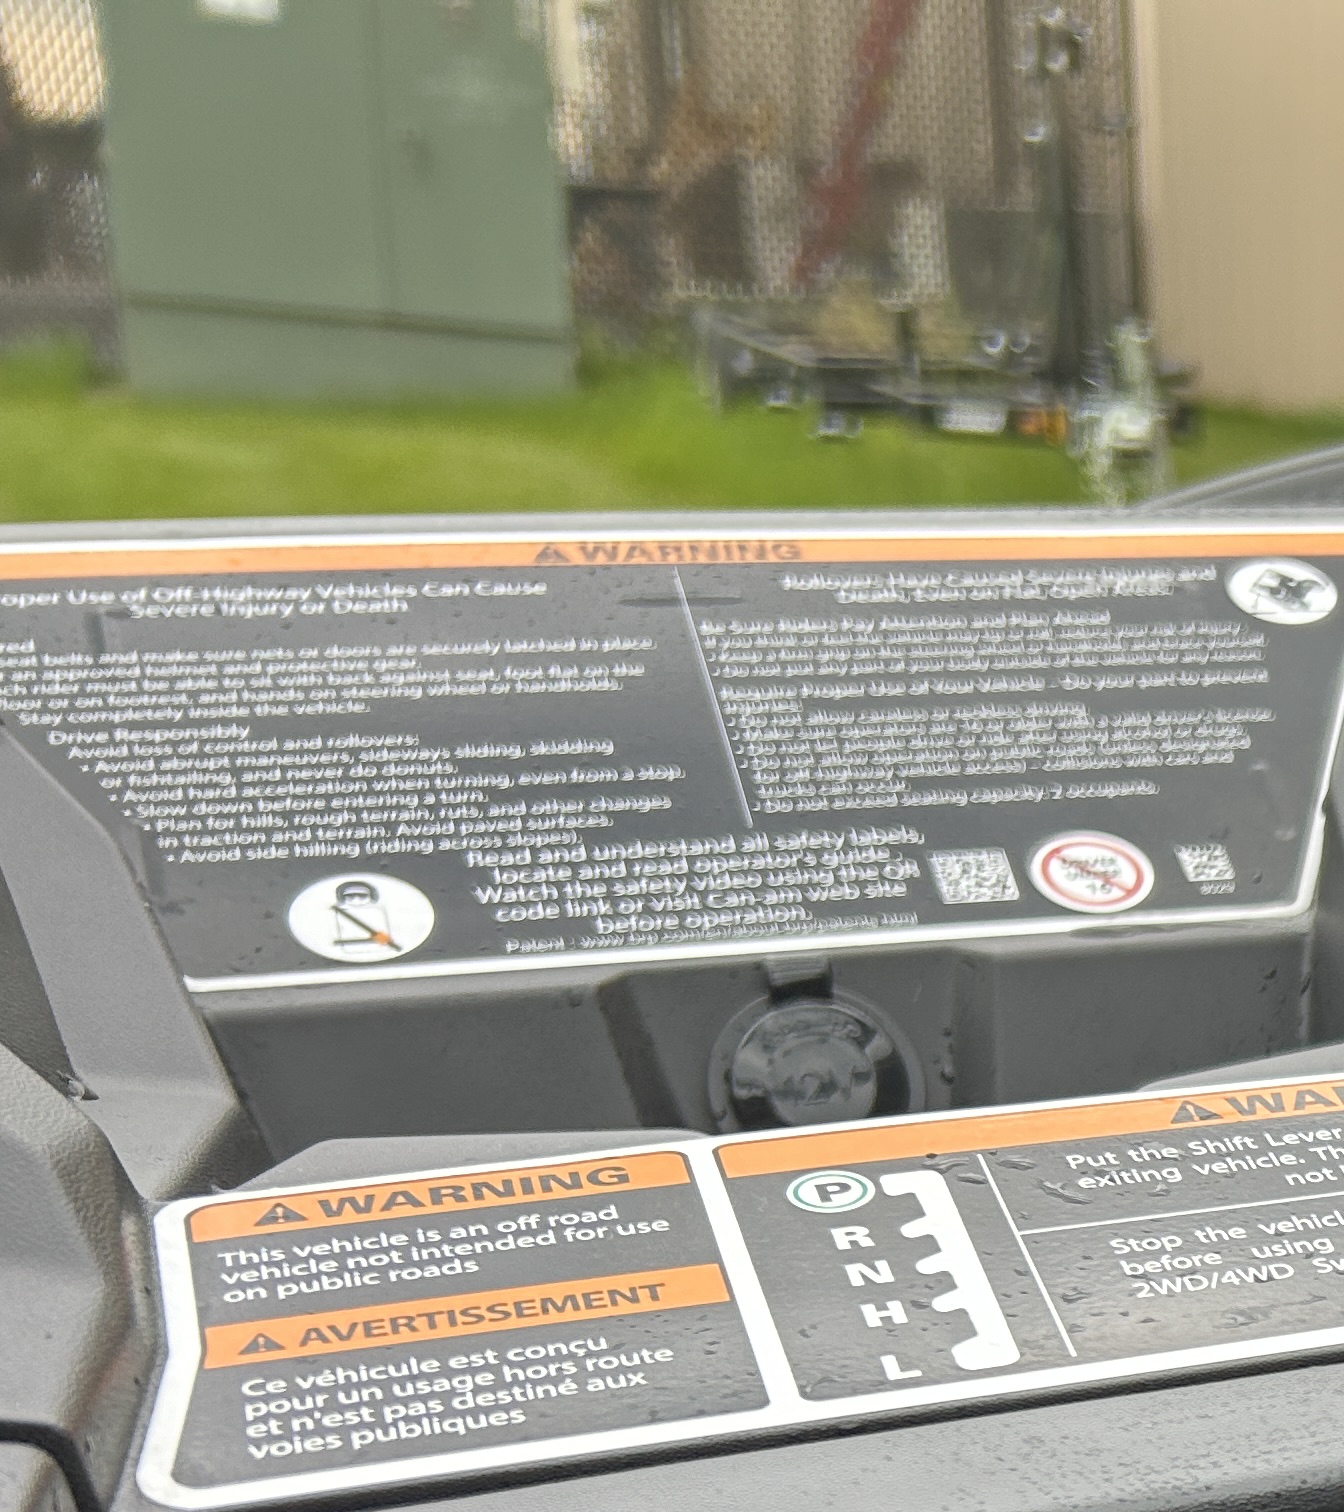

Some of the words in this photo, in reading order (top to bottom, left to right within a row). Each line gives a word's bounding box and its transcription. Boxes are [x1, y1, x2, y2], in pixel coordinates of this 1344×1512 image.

[578, 542, 801, 562] WARNING
[47, 730, 110, 746] Drive
[113, 722, 250, 748] Responsibly
[464, 847, 532, 868] Read
[536, 845, 586, 865] and
[591, 836, 737, 861] understand
[743, 834, 770, 853] all
[773, 831, 845, 854] safety
[1064, 1151, 1121, 1170] Put
[1126, 1143, 1187, 1163] the
[1187, 1135, 1259, 1156] Shift
[1263, 1127, 1343, 1147] Lever
[319, 1166, 632, 1218] WARNING
[815, 1181, 853, 1203] P
[1075, 1166, 1183, 1196] exiting
[1190, 1151, 1306, 1176] vehicle.
[1284, 1167, 1339, 1186] not
[217, 1247, 286, 1267] This
[291, 1232, 410, 1259] vehicle
[416, 1228, 443, 1243] is
[449, 1224, 490, 1239] an
[496, 1213, 541, 1233] off
[547, 1204, 620, 1228] road
[220, 1258, 339, 1285] vehicle
[346, 1249, 405, 1270] not
[410, 1229, 557, 1262] intended
[563, 1225, 609, 1243] for
[615, 1219, 670, 1236] use
[830, 1225, 875, 1251] R
[1108, 1233, 1183, 1255] Stop
[1192, 1226, 1248, 1244] the
[845, 1260, 895, 1287] N
[1119, 1252, 1224, 1279] before
[1248, 1237, 1335, 1265] using
[223, 1286, 268, 1303] on
[276, 1270, 381, 1300] public
[388, 1257, 480, 1283] roads
[1129, 1262, 1295, 1299] 2WD/4WD
[299, 1283, 667, 1348] AVERTISSEMENT
[860, 1301, 909, 1328] H
[241, 1377, 288, 1397] Ce
[294, 1356, 441, 1390] véhicule
[447, 1348, 501, 1369] est
[506, 1336, 609, 1369] conçu
[244, 1393, 330, 1422] pour
[336, 1386, 384, 1405] un
[391, 1371, 496, 1398] usage
[502, 1360, 578, 1383] hors
[585, 1348, 674, 1372] route
[880, 1354, 923, 1381] L
[246, 1417, 284, 1438] et
[290, 1405, 377, 1433] n'est
[382, 1399, 445, 1425] pas
[451, 1377, 579, 1410] destiné
[585, 1371, 649, 1392] aux
[247, 1434, 343, 1460] voies
[350, 1408, 527, 1451] publiques
